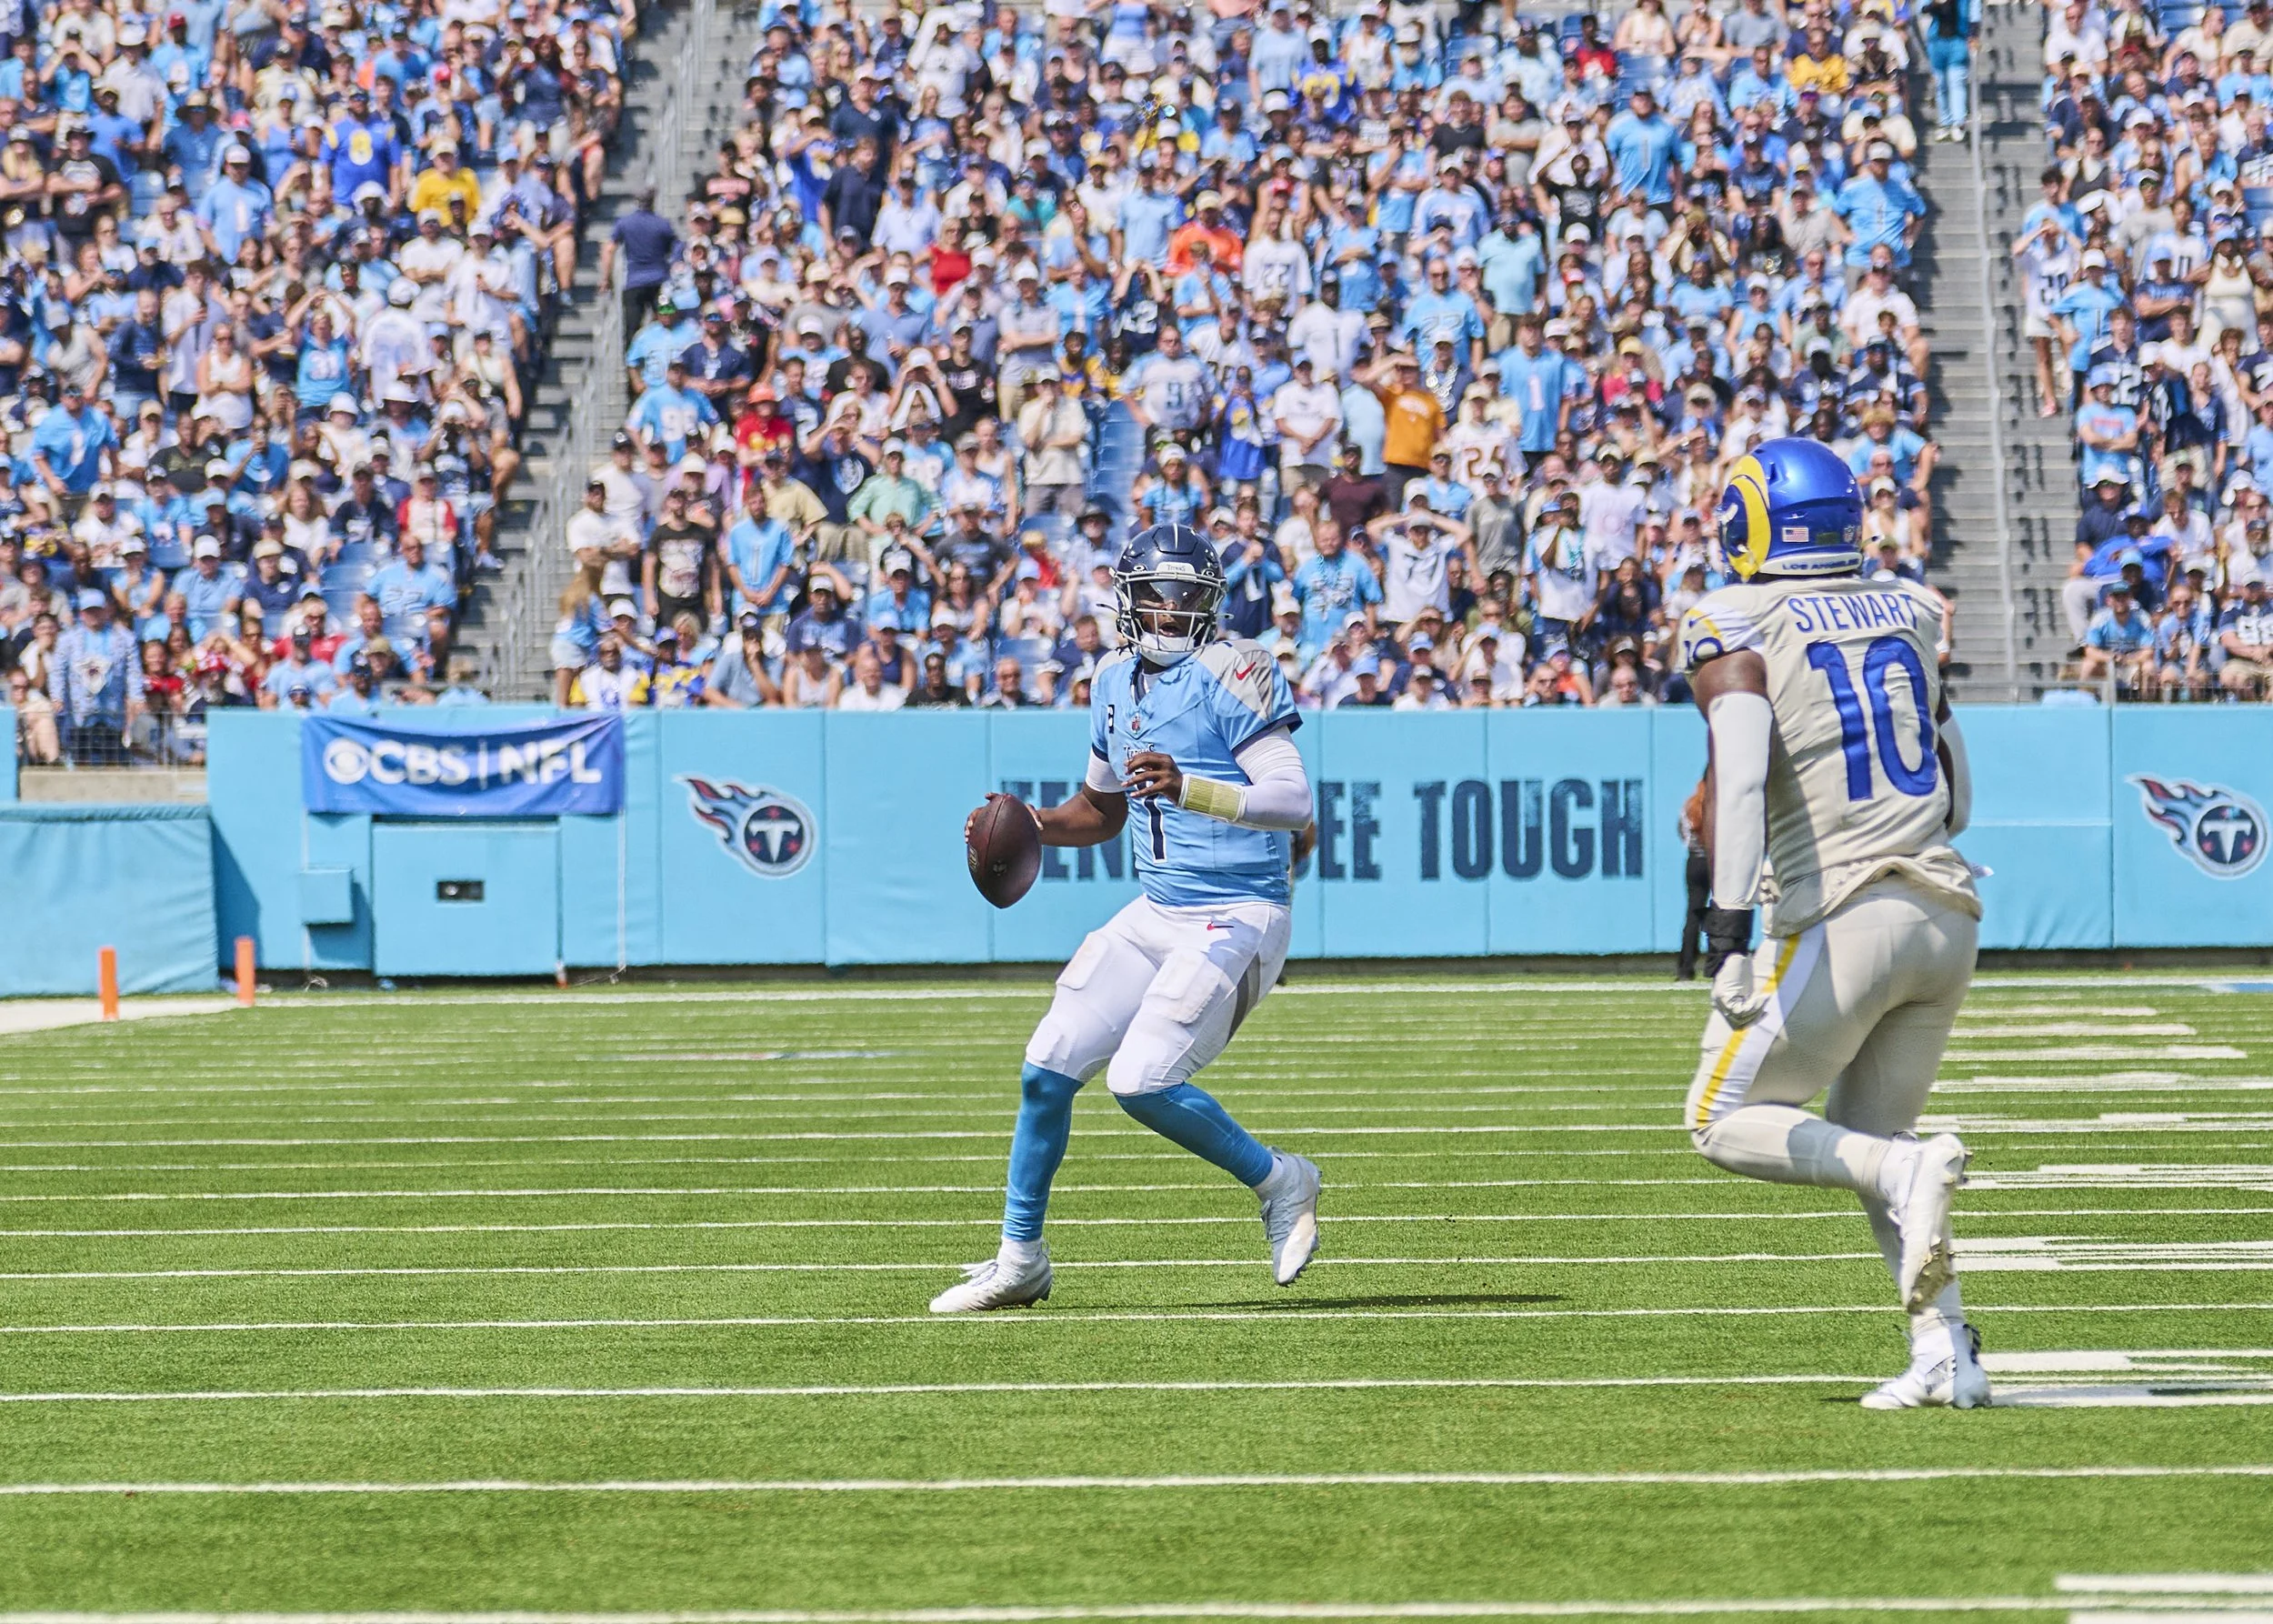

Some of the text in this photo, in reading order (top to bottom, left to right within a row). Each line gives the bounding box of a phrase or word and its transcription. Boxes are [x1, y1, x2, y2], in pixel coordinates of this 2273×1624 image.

[1787, 593, 1918, 634] STEWART
[1806, 636, 1938, 802] 10
[369, 738, 602, 786] CBS NFL
[1413, 778, 1643, 880] TOUGH
